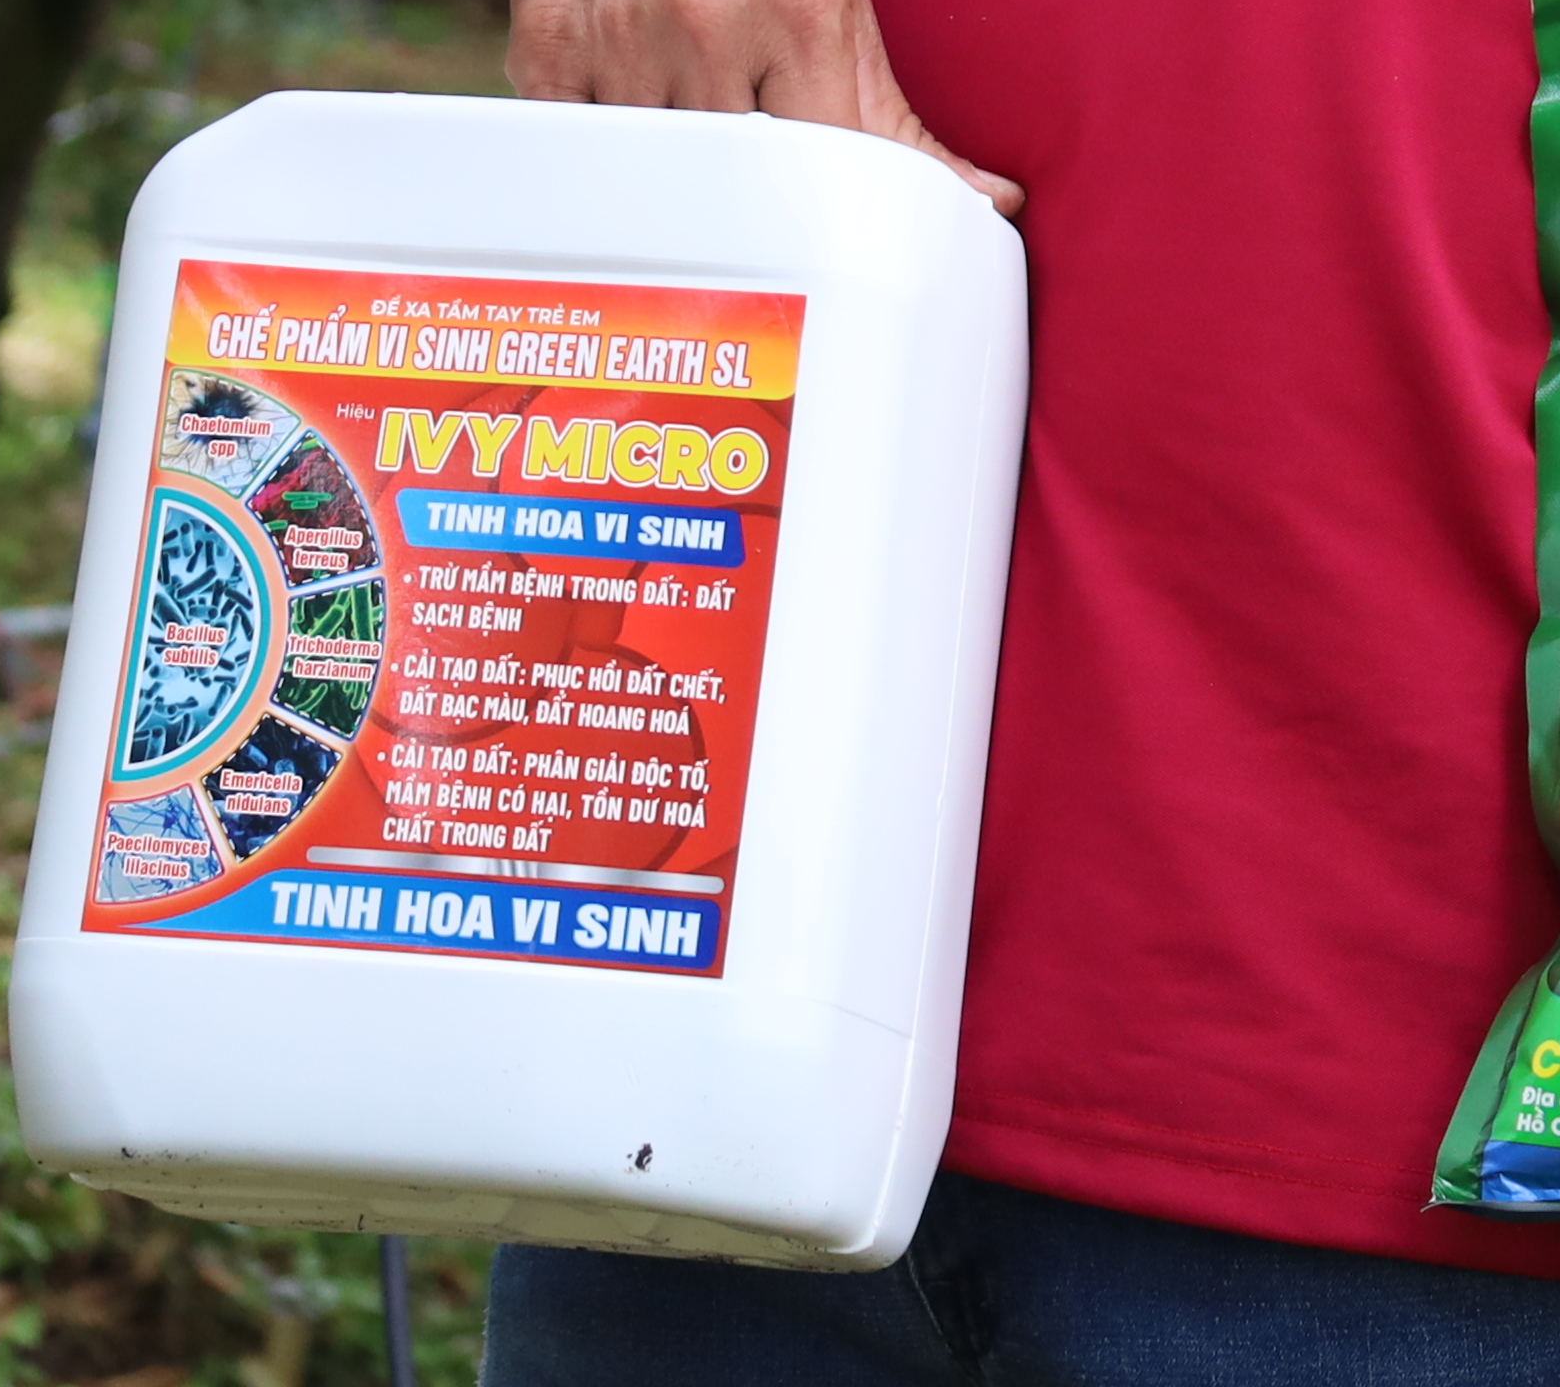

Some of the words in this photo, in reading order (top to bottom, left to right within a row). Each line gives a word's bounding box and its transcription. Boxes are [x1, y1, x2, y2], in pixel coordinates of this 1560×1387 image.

[370, 295, 401, 317] ĐỂ
[404, 302, 431, 318] XA
[485, 305, 524, 324] TAY
[527, 303, 564, 325] TRẺ
[569, 309, 601, 327] EM
[208, 303, 277, 359] CHẾ
[275, 304, 371, 367] PHẨM
[377, 324, 410, 369] VI
[412, 325, 492, 373] SINH
[496, 329, 600, 379] GREEN
[605, 335, 708, 385] EARTH
[712, 342, 751, 389] SL
[336, 403, 376, 421] Hiệu
[180, 414, 272, 436] Chaetomium
[209, 441, 237, 457] spp
[375, 407, 522, 477] IVY
[522, 416, 769, 495] MICRO
[427, 501, 506, 535] TINH
[513, 507, 584, 541] HOA
[595, 512, 630, 543] VI
[638, 516, 726, 551] SINH
[286, 527, 362, 548] Apergillus
[294, 550, 347, 569] terreus
[418, 563, 461, 591] TRỪ
[510, 569, 565, 603] BỆNH
[570, 575, 637, 604] TRONG
[642, 575, 690, 608] ĐẤT:
[695, 579, 736, 611] ĐẤT
[411, 601, 462, 633] SẠCH
[468, 601, 523, 637] BỆNH
[166, 625, 225, 643] Bacillus
[164, 649, 217, 666] subtilis
[289, 637, 380, 657] Trichoderma
[294, 661, 373, 679] harzianum
[403, 649, 435, 679] CẢI
[441, 657, 477, 688] TẠO
[482, 654, 527, 686] ĐẤT:
[531, 663, 585, 697] PHỤC
[588, 659, 623, 693] HỒI
[627, 664, 667, 696] ĐẤT
[668, 668, 726, 704] CHẾT,
[399, 683, 438, 716] ĐẤT
[440, 693, 479, 725] BẠC
[483, 692, 531, 725] MÀU,
[578, 703, 645, 731] HOANG
[649, 706, 690, 736] HOÁ
[390, 738, 425, 769] CẢI
[430, 746, 467, 780] TẠO
[472, 742, 519, 775] ĐẤT:
[523, 749, 581, 780] PHÂN
[583, 751, 627, 785] GIẢI
[630, 757, 673, 794] ĐỘC
[679, 759, 712, 794] TỐ,
[220, 771, 302, 792] Emericella
[225, 794, 290, 815] nidulans
[436, 779, 492, 815] BỆNH
[497, 783, 527, 812] CÓ
[531, 791, 573, 824] HẠI,
[580, 785, 623, 821] TỒN
[627, 797, 659, 824] DƯ
[662, 797, 706, 829] HOÁ
[382, 812, 435, 844] CHẤT
[440, 821, 507, 850] TRONG
[512, 818, 553, 853] ĐẤT
[106, 835, 210, 857] Paecilomyces
[124, 858, 188, 878] lilacinus
[270, 881, 383, 932] TINH
[394, 889, 495, 941] HOA
[512, 897, 561, 945] VI
[573, 903, 701, 957] SINH
[1522, 1087, 1555, 1108] Địa
[1516, 1107, 1545, 1134] Hồ
